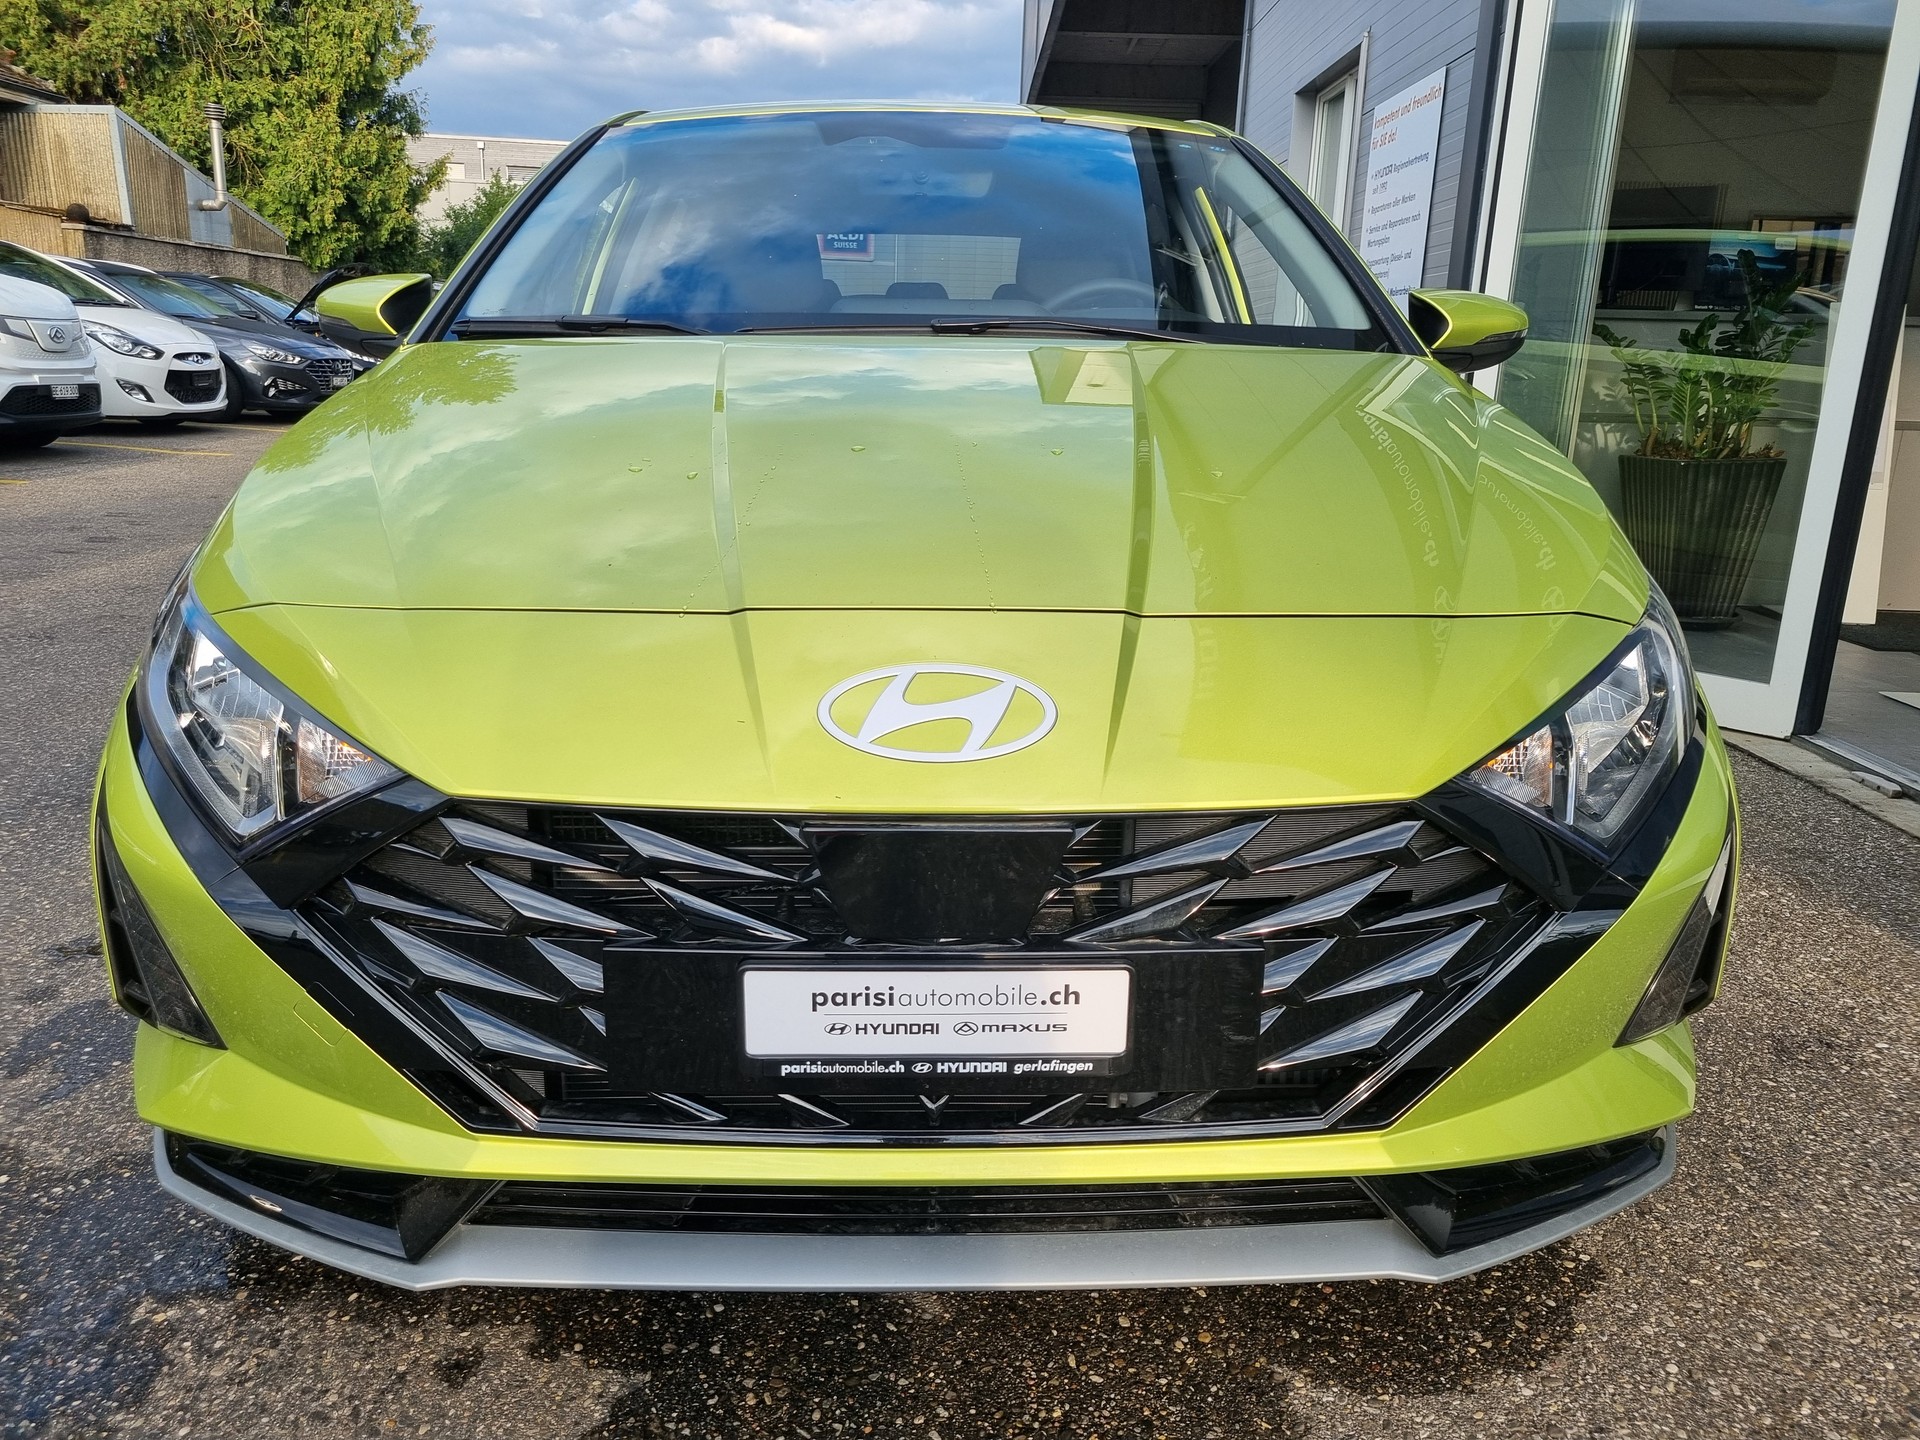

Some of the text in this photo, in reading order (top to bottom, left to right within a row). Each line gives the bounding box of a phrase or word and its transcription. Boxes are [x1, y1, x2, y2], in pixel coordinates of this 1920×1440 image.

[1374, 82, 1442, 130] kompetent und freundlich
[1371, 136, 1379, 151] für
[1387, 127, 1398, 144] da!
[1373, 152, 1430, 181] HYUNDAI Regionalvertretung
[1371, 192, 1416, 216] Reparaturen aller Marken
[1368, 210, 1421, 234] Service und Reparaturen nach
[833, 241, 858, 249] SUISSE
[1367, 235, 1390, 248] Wartungsplan
[1403, 249, 1413, 260] und
[811, 984, 1081, 1012] parisiautomobile.ch
[855, 1022, 1068, 1035] HYUNDAI MAXUS
[781, 1060, 1094, 1076] parisiautomobile.ch HYUNDAI gerlafingen
